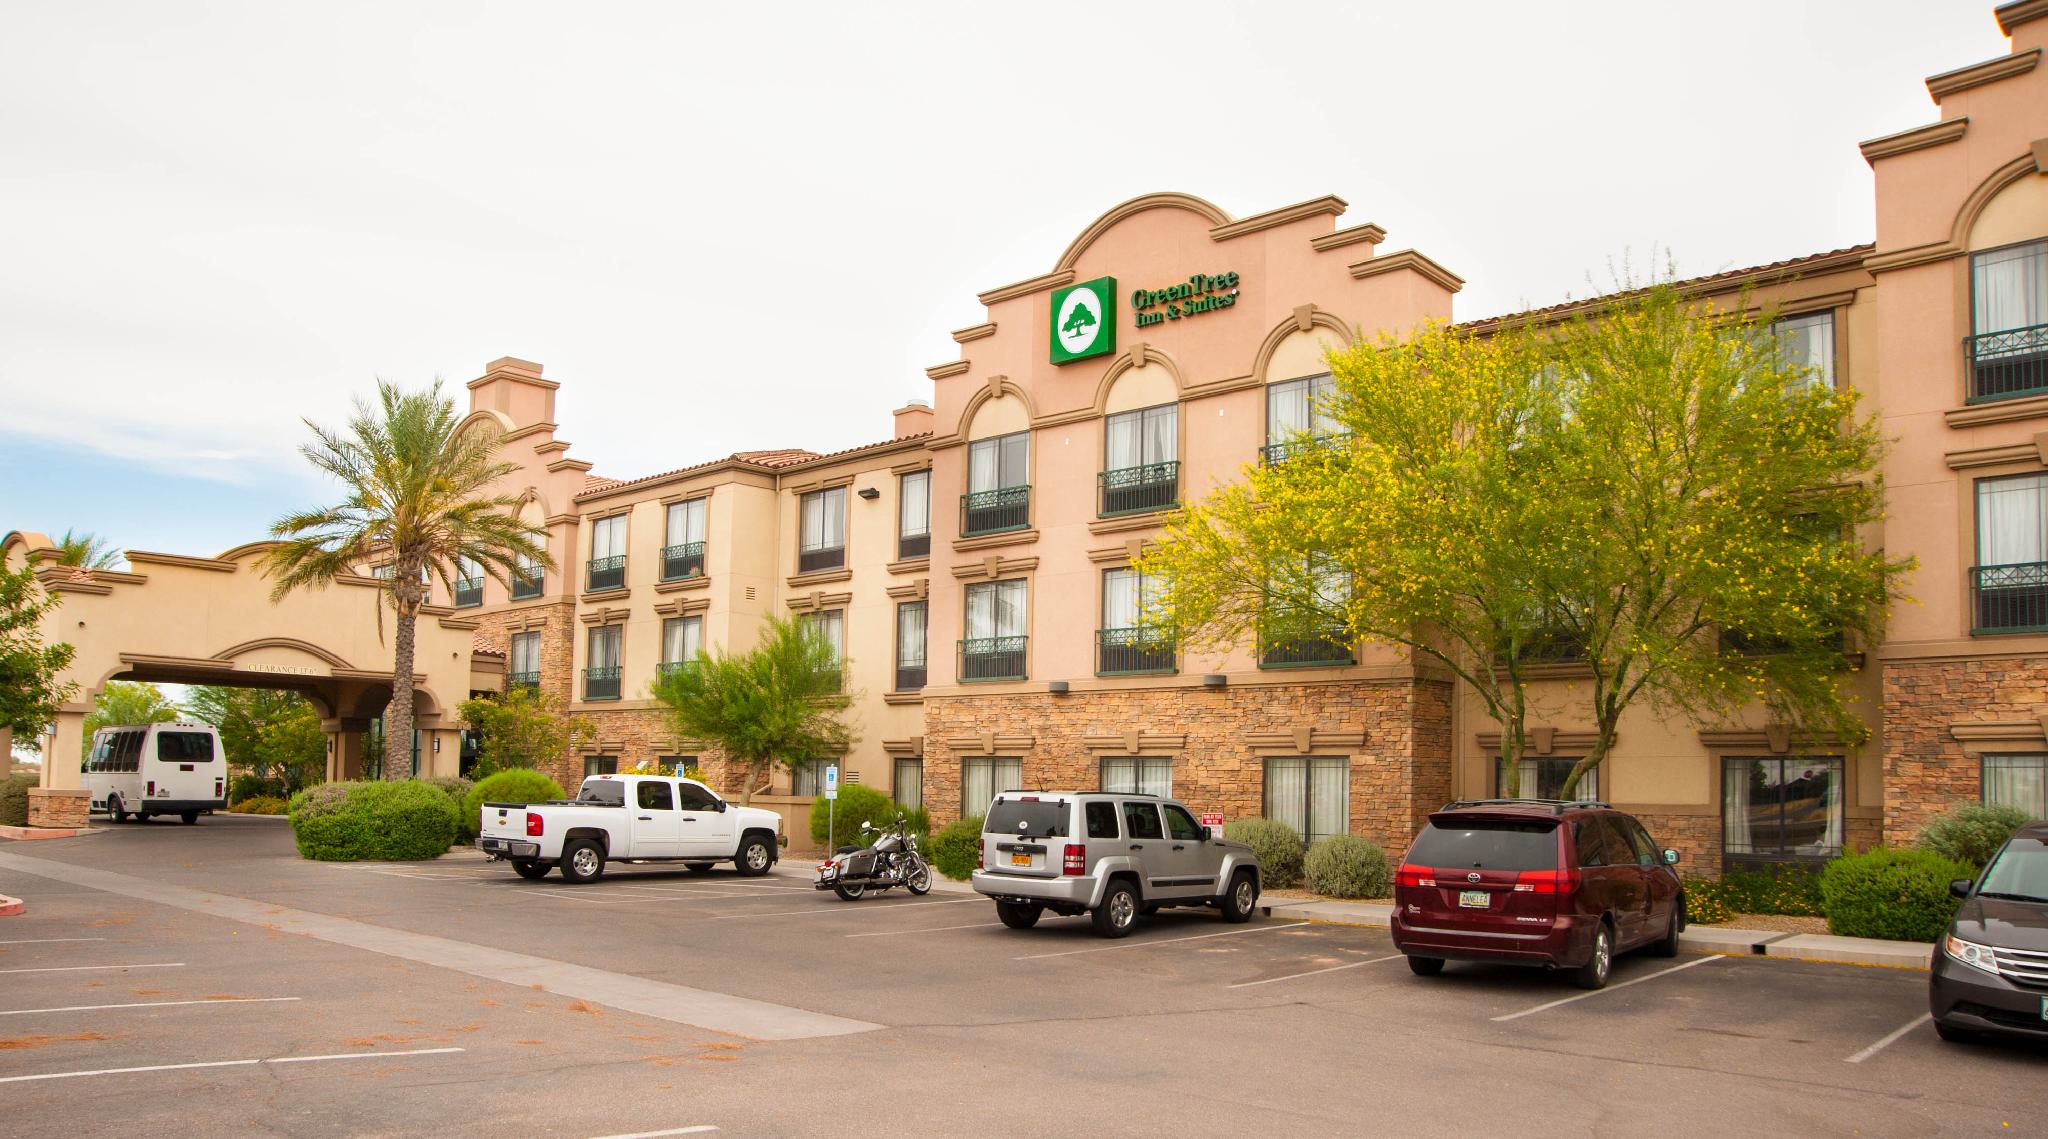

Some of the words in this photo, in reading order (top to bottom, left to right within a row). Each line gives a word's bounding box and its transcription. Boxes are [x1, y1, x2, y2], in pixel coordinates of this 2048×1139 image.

[1131, 271, 1239, 310] GreenTree
[1134, 311, 1164, 328] Inn
[1166, 304, 1181, 320] &
[1181, 293, 1236, 317] Suites
[248, 664, 297, 674] CLEARANCE
